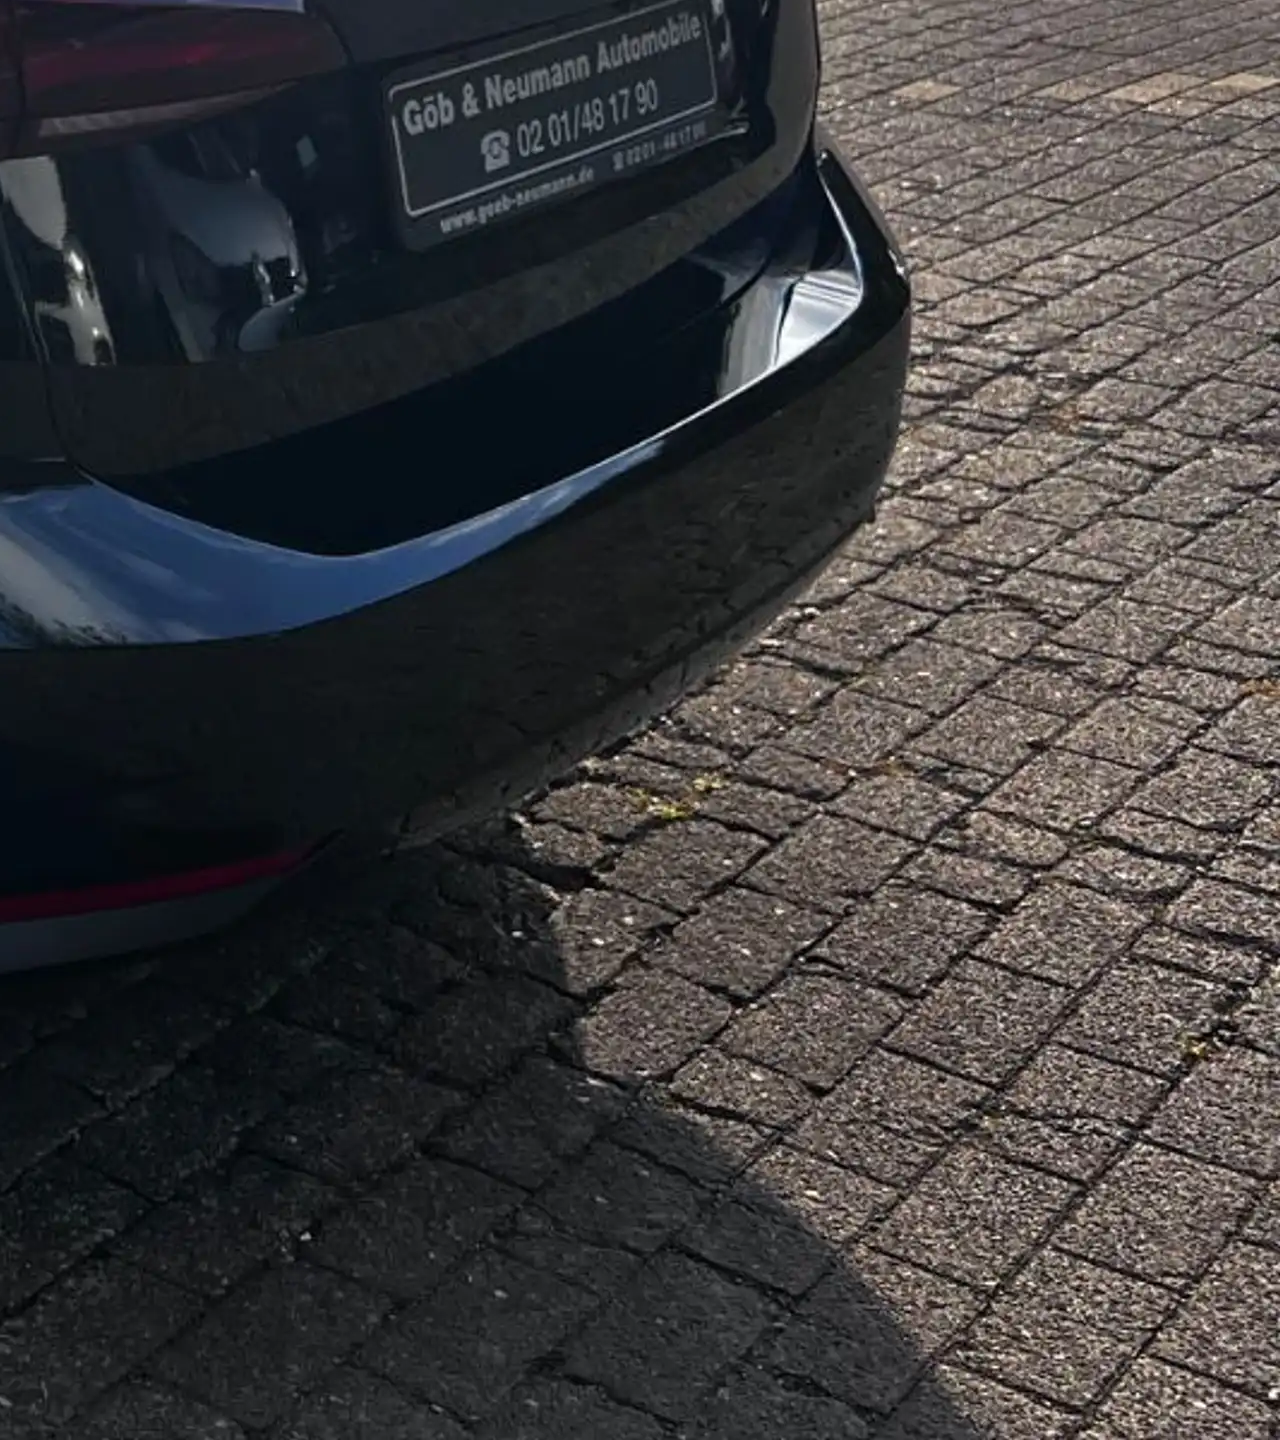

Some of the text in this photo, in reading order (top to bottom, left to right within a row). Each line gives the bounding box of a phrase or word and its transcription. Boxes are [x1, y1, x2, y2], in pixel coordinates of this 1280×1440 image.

[402, 12, 703, 137] Göb & Neumann Automobile
[516, 78, 660, 158] 02 01/48 17 90
